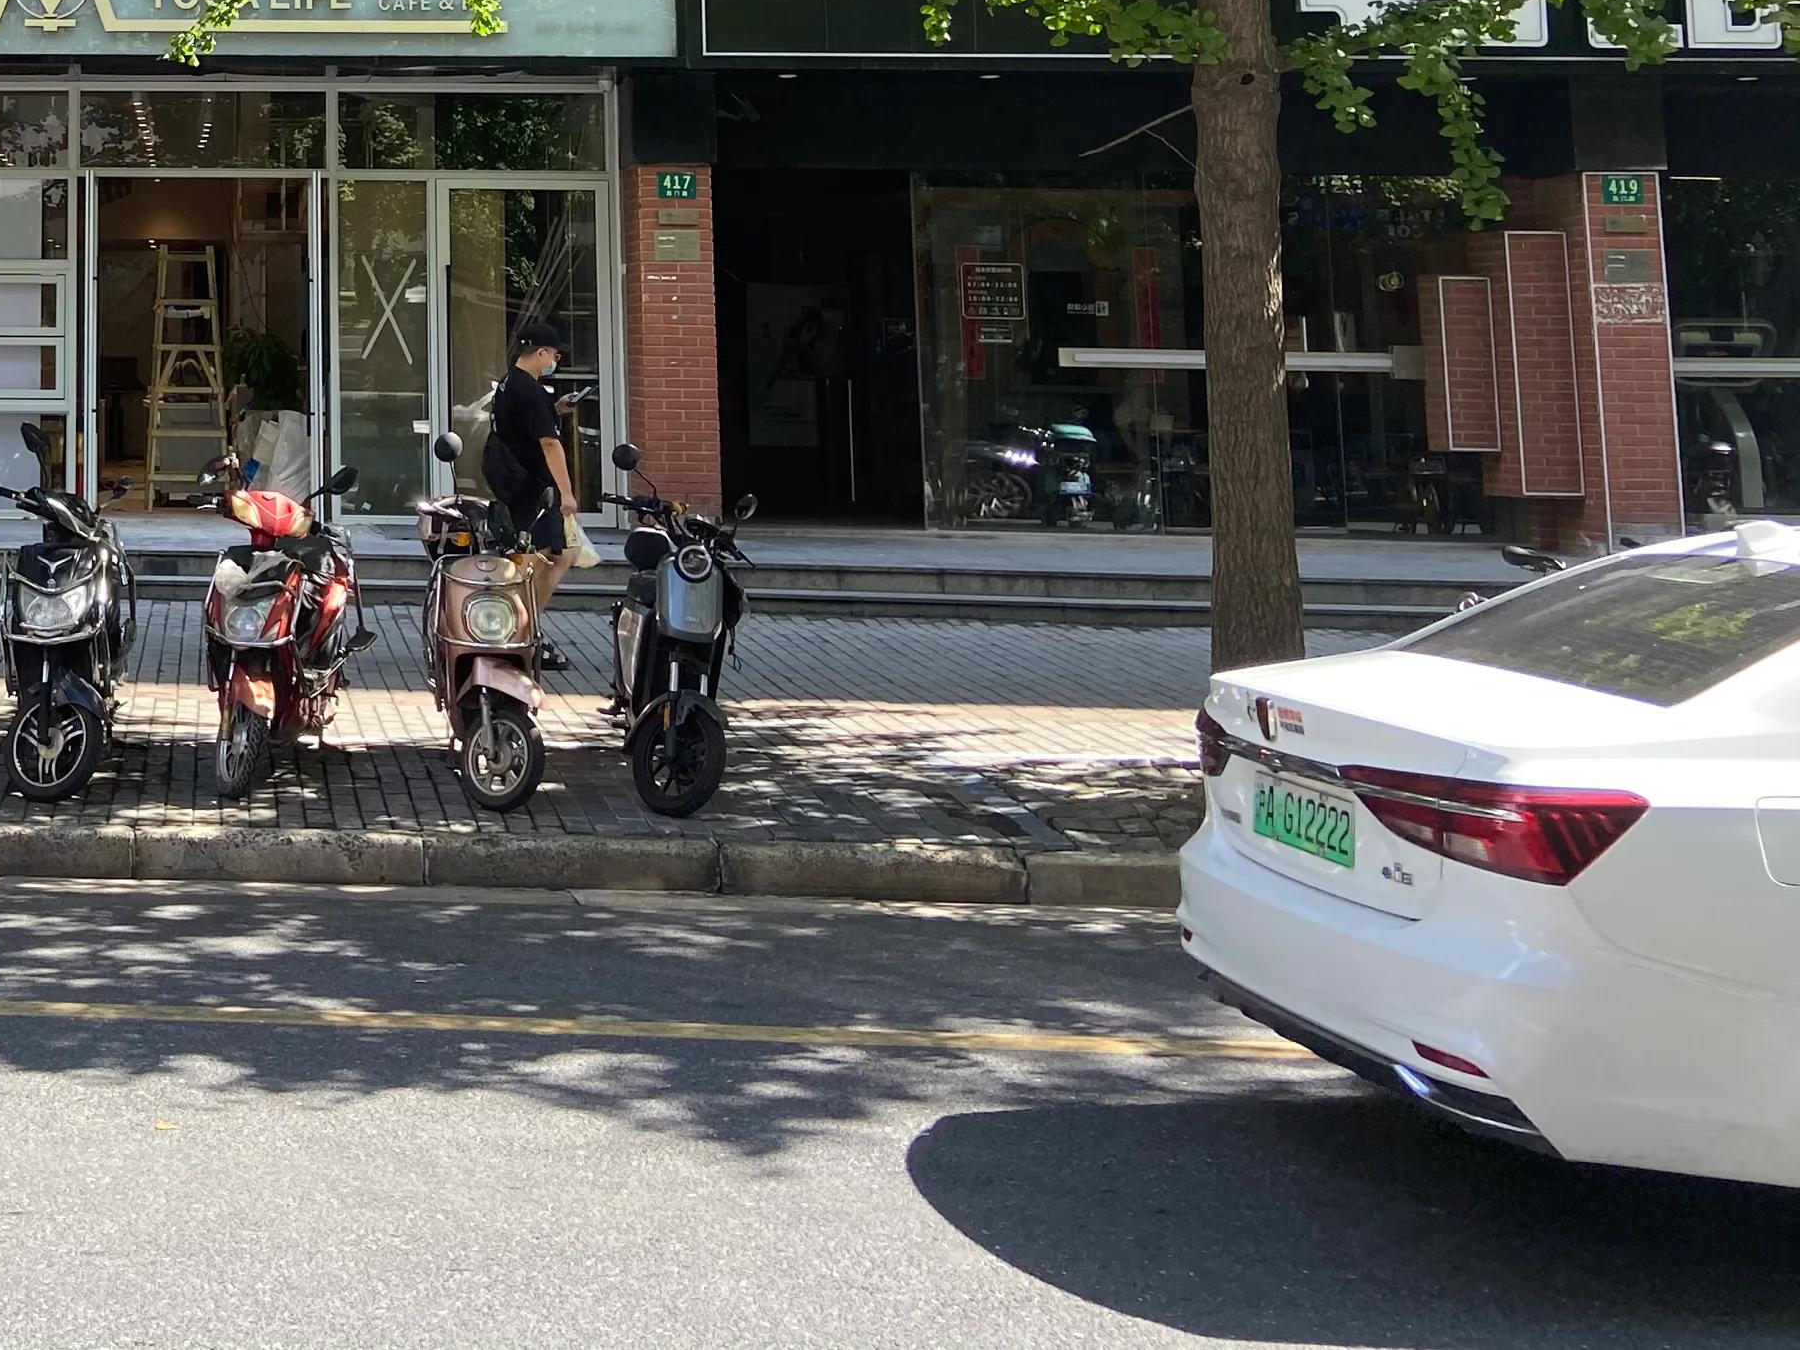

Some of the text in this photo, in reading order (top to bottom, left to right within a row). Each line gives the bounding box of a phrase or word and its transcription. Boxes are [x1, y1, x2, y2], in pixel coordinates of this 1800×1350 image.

[663, 175, 692, 189] 417
[1608, 179, 1639, 195] 419
[1284, 791, 1351, 856] G12222
